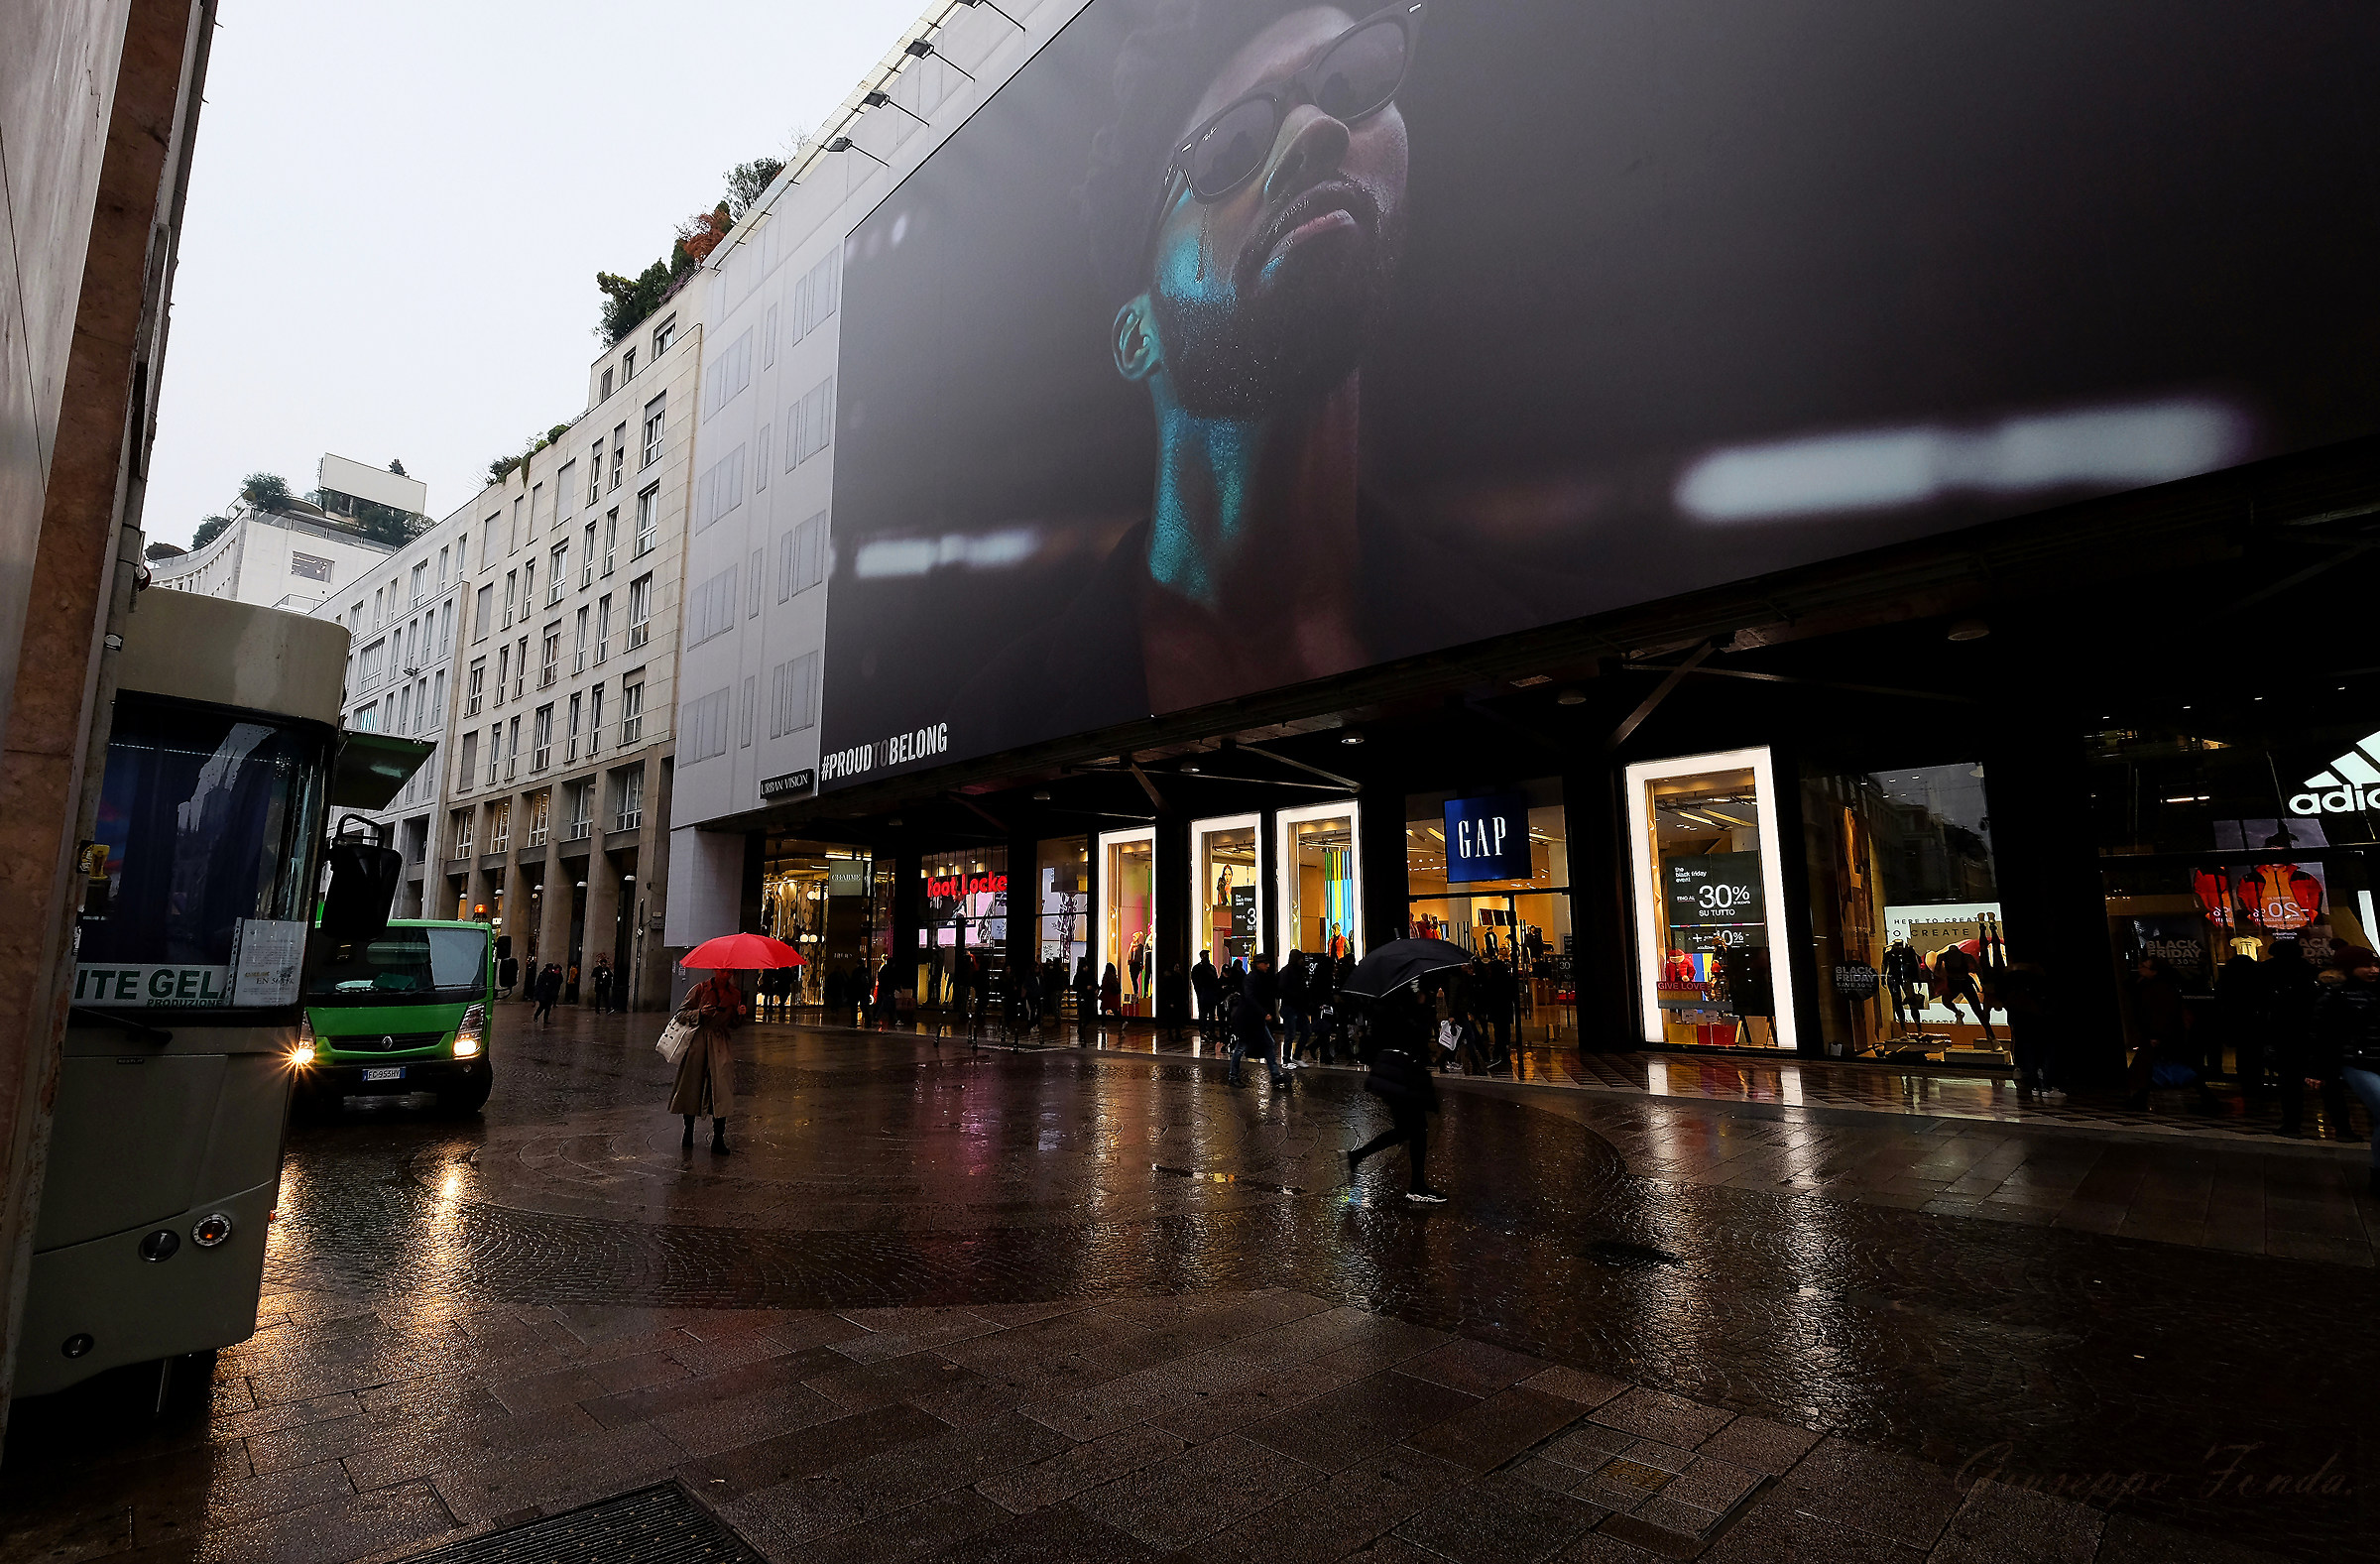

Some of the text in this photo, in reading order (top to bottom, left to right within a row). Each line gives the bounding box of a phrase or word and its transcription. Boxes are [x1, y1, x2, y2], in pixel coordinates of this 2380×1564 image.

[820, 722, 948, 782] #PROUDTOBELONG
[760, 773, 808, 794] URBAN VISION
[1458, 816, 1506, 859] GAP
[927, 871, 1008, 898] Foot Locke
[1699, 884, 1750, 908] 30%
[1910, 928, 1969, 937] CREATE
[2146, 939, 2200, 950] BLACK
[2147, 948, 2202, 959] FRIDAY
[1835, 965, 1873, 975] BLACK
[1836, 973, 1875, 983] FRIDAY
